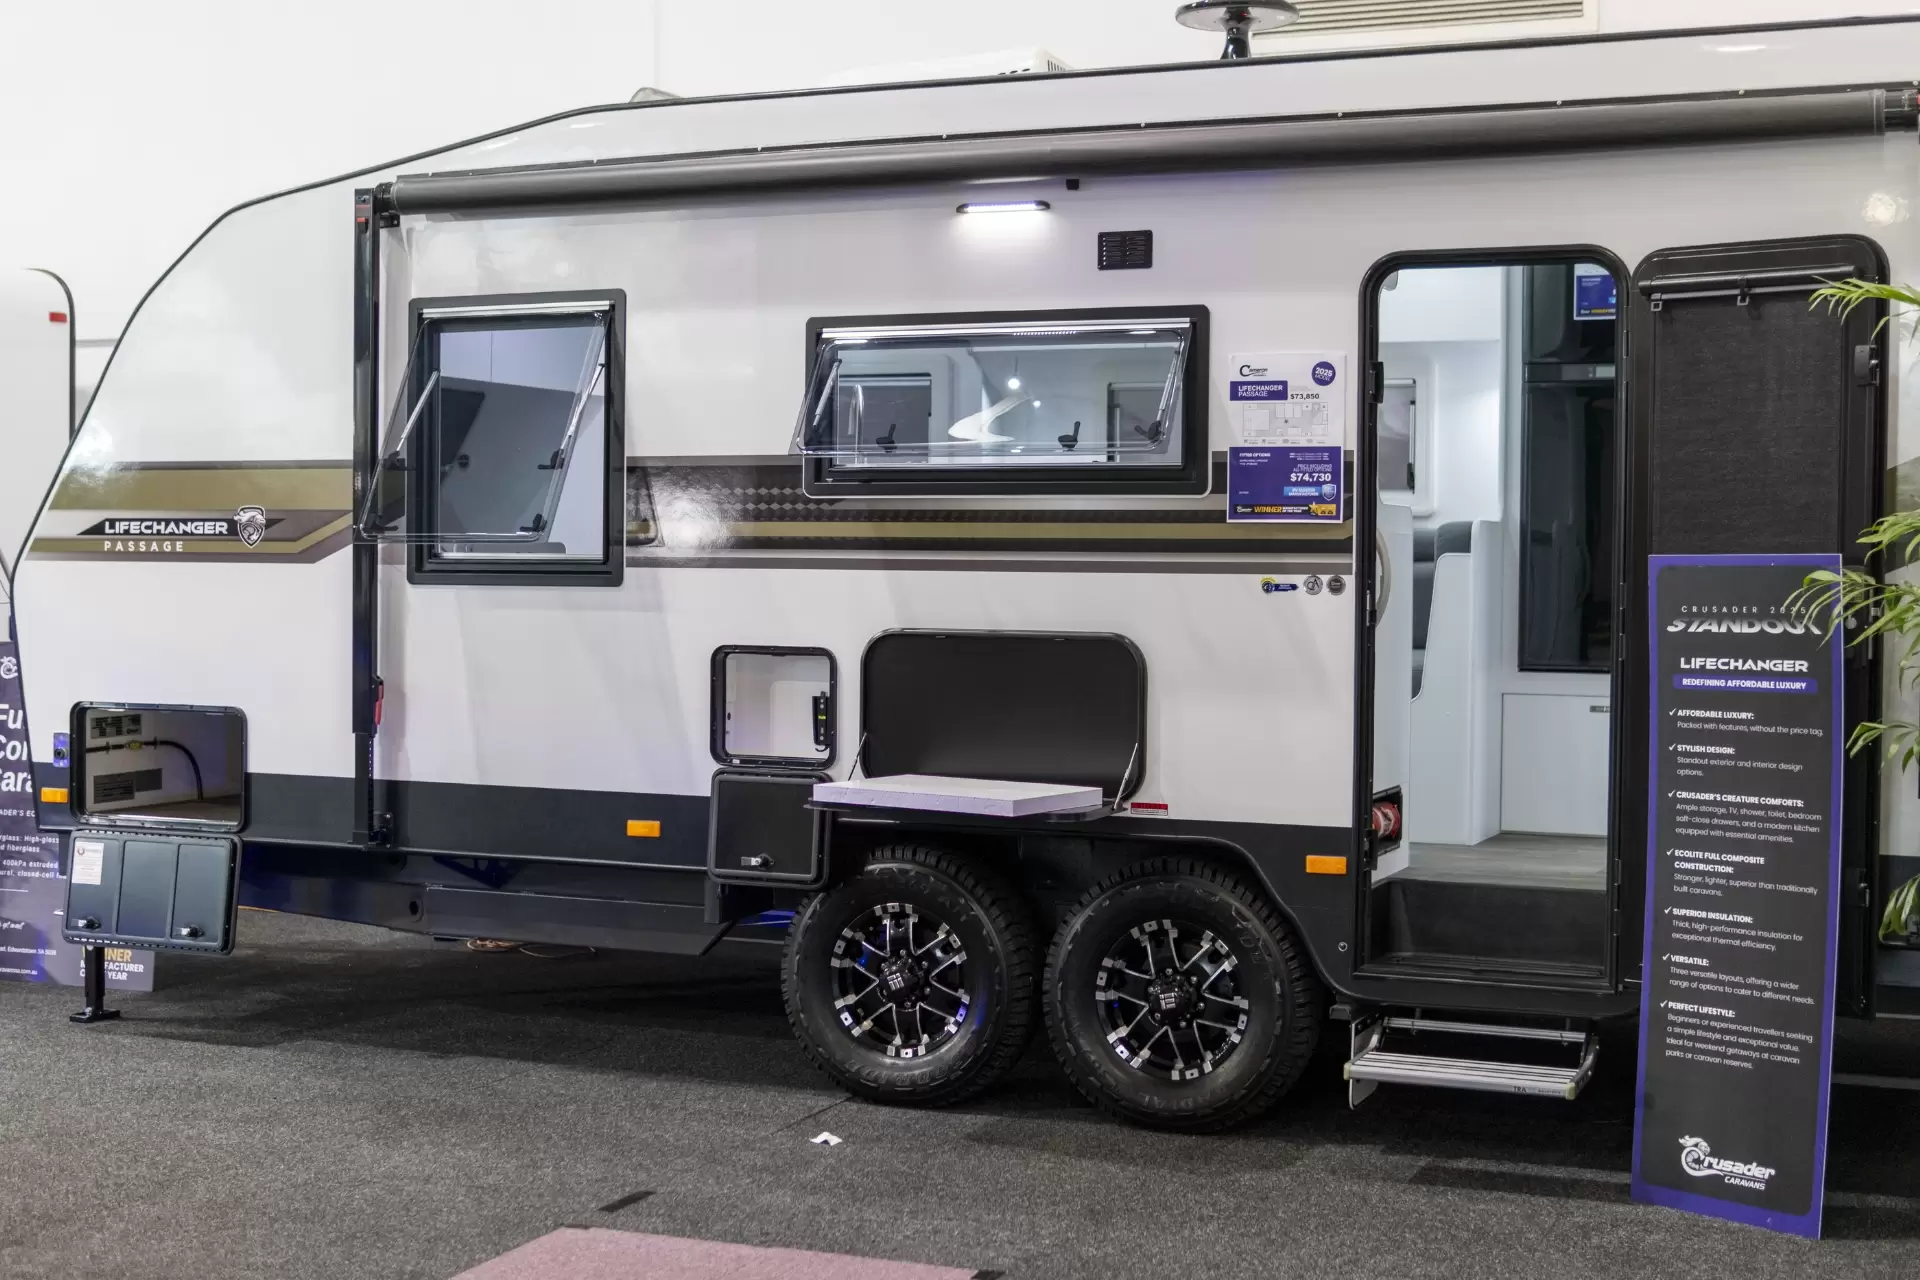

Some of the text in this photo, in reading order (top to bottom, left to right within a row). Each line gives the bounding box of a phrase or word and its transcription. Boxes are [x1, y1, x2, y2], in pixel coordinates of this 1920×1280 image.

[1240, 365, 1268, 377] Cameron
[1315, 367, 1333, 377] 2025
[1290, 473, 1332, 482] $74,730
[105, 521, 228, 535] LIFECHANGER
[104, 540, 184, 552] PASSAGE
[1680, 657, 1808, 672] LIFECHANGER
[1682, 678, 1726, 687] REDEFINING
[1727, 679, 1775, 688] AFFORDABLE
[1678, 709, 1754, 719] AFFORDABLE LUXURY:
[1719, 723, 1748, 732] features,
[1790, 727, 1808, 735] price
[1677, 745, 1735, 754] STYLISH DESIGN:
[1677, 756, 1708, 765] Standout
[1710, 758, 1735, 766] exterior
[1752, 760, 1777, 769] interior
[1778, 762, 1803, 772] design
[1677, 768, 1703, 777] options.
[1676, 791, 1804, 807] CRUSADER'S CREATURE COMFORTS:
[1676, 804, 1698, 812] Ample
[1699, 806, 1728, 815] storage,
[1740, 808, 1766, 817] shower,
[1768, 810, 1787, 818] toilet,
[1788, 812, 1822, 820] bedroom
[1676, 815, 1710, 824] soft-close
[1764, 822, 1792, 831] modern
[1794, 824, 1820, 832] kitchen
[24, 835, 59, 844] High-gloss
[1676, 827, 1708, 836] equipped
[1725, 831, 1756, 840] essential
[1758, 833, 1794, 843] amenities.
[1675, 850, 1765, 864] ECOLITE FULL COMPOSITE
[1675, 861, 1734, 873] CONSTRUCTION:
[1705, 876, 1727, 885] lighter,
[1729, 879, 1757, 889] superior
[1776, 883, 1818, 896] traditionally
[1673, 908, 1753, 923] SUPERIOR INSULATION:
[1692, 922, 1756, 936] high-performance
[1757, 929, 1792, 940] insulation
[1793, 933, 1803, 941] for
[1672, 932, 1776, 952] exceptional thermal efficiency.
[1671, 955, 1710, 966] VERSATILE:
[108, 971, 128, 980] YEAR
[1670, 966, 1689, 976] Three
[1690, 970, 1717, 980] versatile
[1719, 973, 1744, 984] layouts,
[1746, 977, 1772, 988] offering
[1780, 981, 1799, 990] wider
[1670, 979, 1689, 989] range
[1699, 982, 1723, 993] options
[1734, 988, 1752, 996] cater
[1762, 991, 1790, 1002] different
[1792, 995, 1815, 1004] needs.
[1668, 1001, 1735, 1018] PERFECT LIFESTYLE:
[1668, 1013, 1700, 1025] Beginners
[1710, 1020, 1752, 1032] experienced
[1753, 1026, 1784, 1037] travellers
[1786, 1032, 1813, 1043] seeking
[1674, 1026, 1695, 1036] simple
[1696, 1029, 1721, 1040] lifestyle
[1723, 1033, 1736, 1042] and
[1738, 1036, 1778, 1049] exceptional
[1780, 1042, 1800, 1052] value.
[1666, 1037, 1683, 1046] Ideal
[1694, 1042, 1725, 1052] weekend
[1726, 1046, 1760, 1059] getaways
[1770, 1055, 1799, 1064] caravan
[1666, 1049, 1684, 1058] parks
[1694, 1054, 1722, 1064] caravan
[1724, 1059, 1753, 1069] reserves.
[1681, 1146, 1776, 1179] Crusader
[1725, 1176, 1766, 1190] CARAVANS
